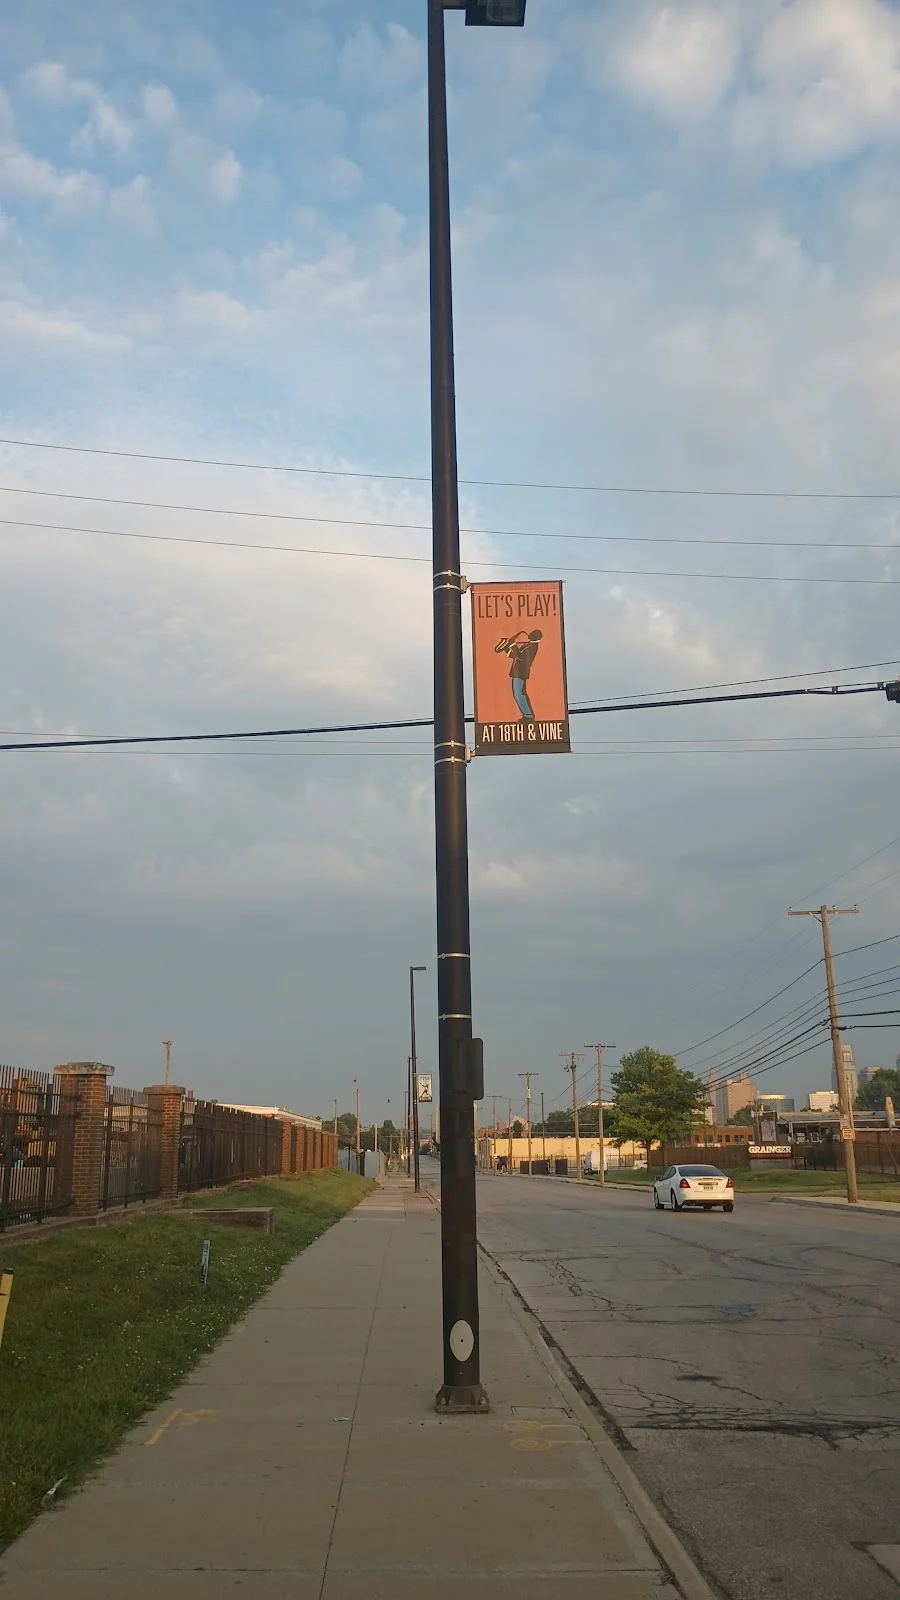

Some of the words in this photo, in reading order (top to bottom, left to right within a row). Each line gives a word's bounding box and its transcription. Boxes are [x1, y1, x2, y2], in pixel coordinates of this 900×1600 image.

[478, 595, 512, 618] LET'S
[518, 594, 556, 616] PLAY!
[482, 725, 495, 742] AT
[499, 724, 524, 741] 18TH
[528, 724, 536, 740] &
[538, 722, 562, 740] VINE
